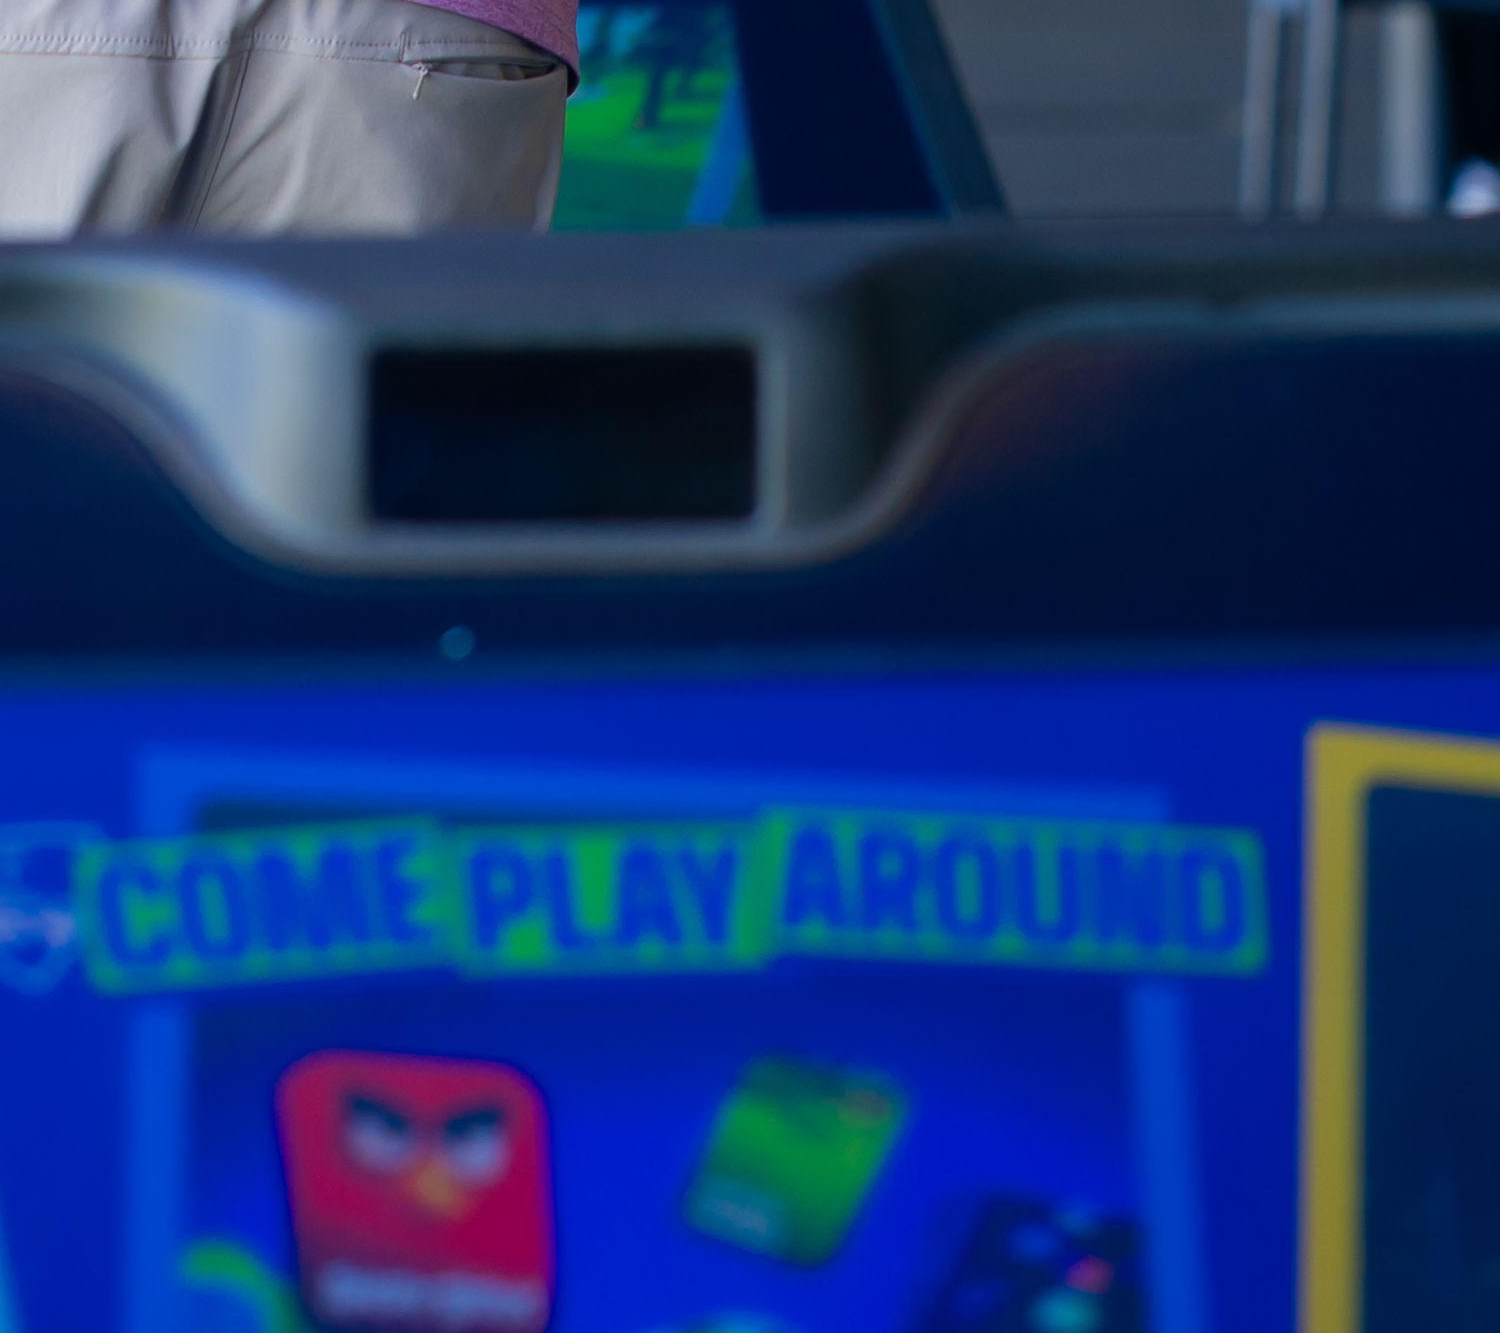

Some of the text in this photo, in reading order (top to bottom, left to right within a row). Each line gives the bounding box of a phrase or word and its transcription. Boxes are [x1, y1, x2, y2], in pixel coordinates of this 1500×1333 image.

[94, 827, 1242, 967] COME PLAY AROUND
